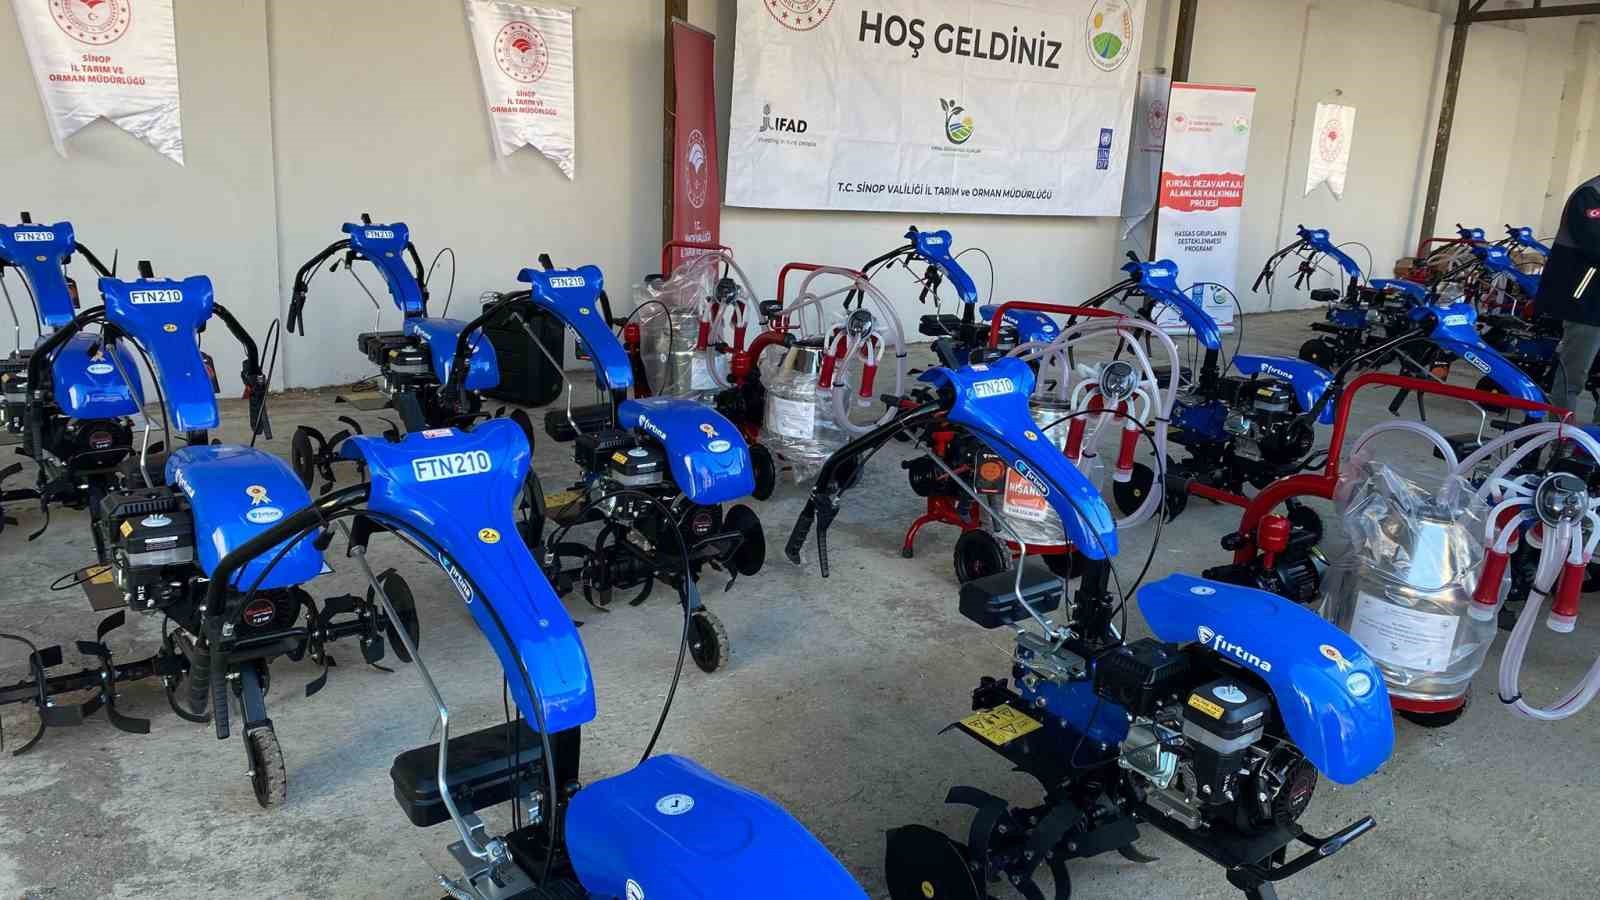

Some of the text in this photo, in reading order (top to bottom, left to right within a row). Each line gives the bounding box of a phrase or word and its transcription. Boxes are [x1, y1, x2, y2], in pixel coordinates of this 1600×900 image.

[859, 10, 925, 58] HOŞ
[934, 23, 1062, 69] GELDİNİZ
[82, 54, 111, 63] SİNOP
[82, 64, 111, 73] TARIM
[113, 66, 124, 74] VE
[49, 74, 145, 86] ORMAN MÜDÜRLÜĞÜ
[775, 117, 807, 133] IFAD
[838, 182, 853, 193] T.C.
[856, 181, 886, 194] SİNOP
[887, 182, 924, 196] VALİLİĞİ
[934, 186, 959, 196] TARIM
[961, 188, 970, 197] ve
[972, 187, 1001, 197] ORMAN
[16, 232, 53, 241] FTN210
[550, 277, 584, 288] FTN210
[132, 290, 181, 303] FTN210
[974, 379, 1012, 396] FTN210
[416, 451, 490, 480] FTN210
